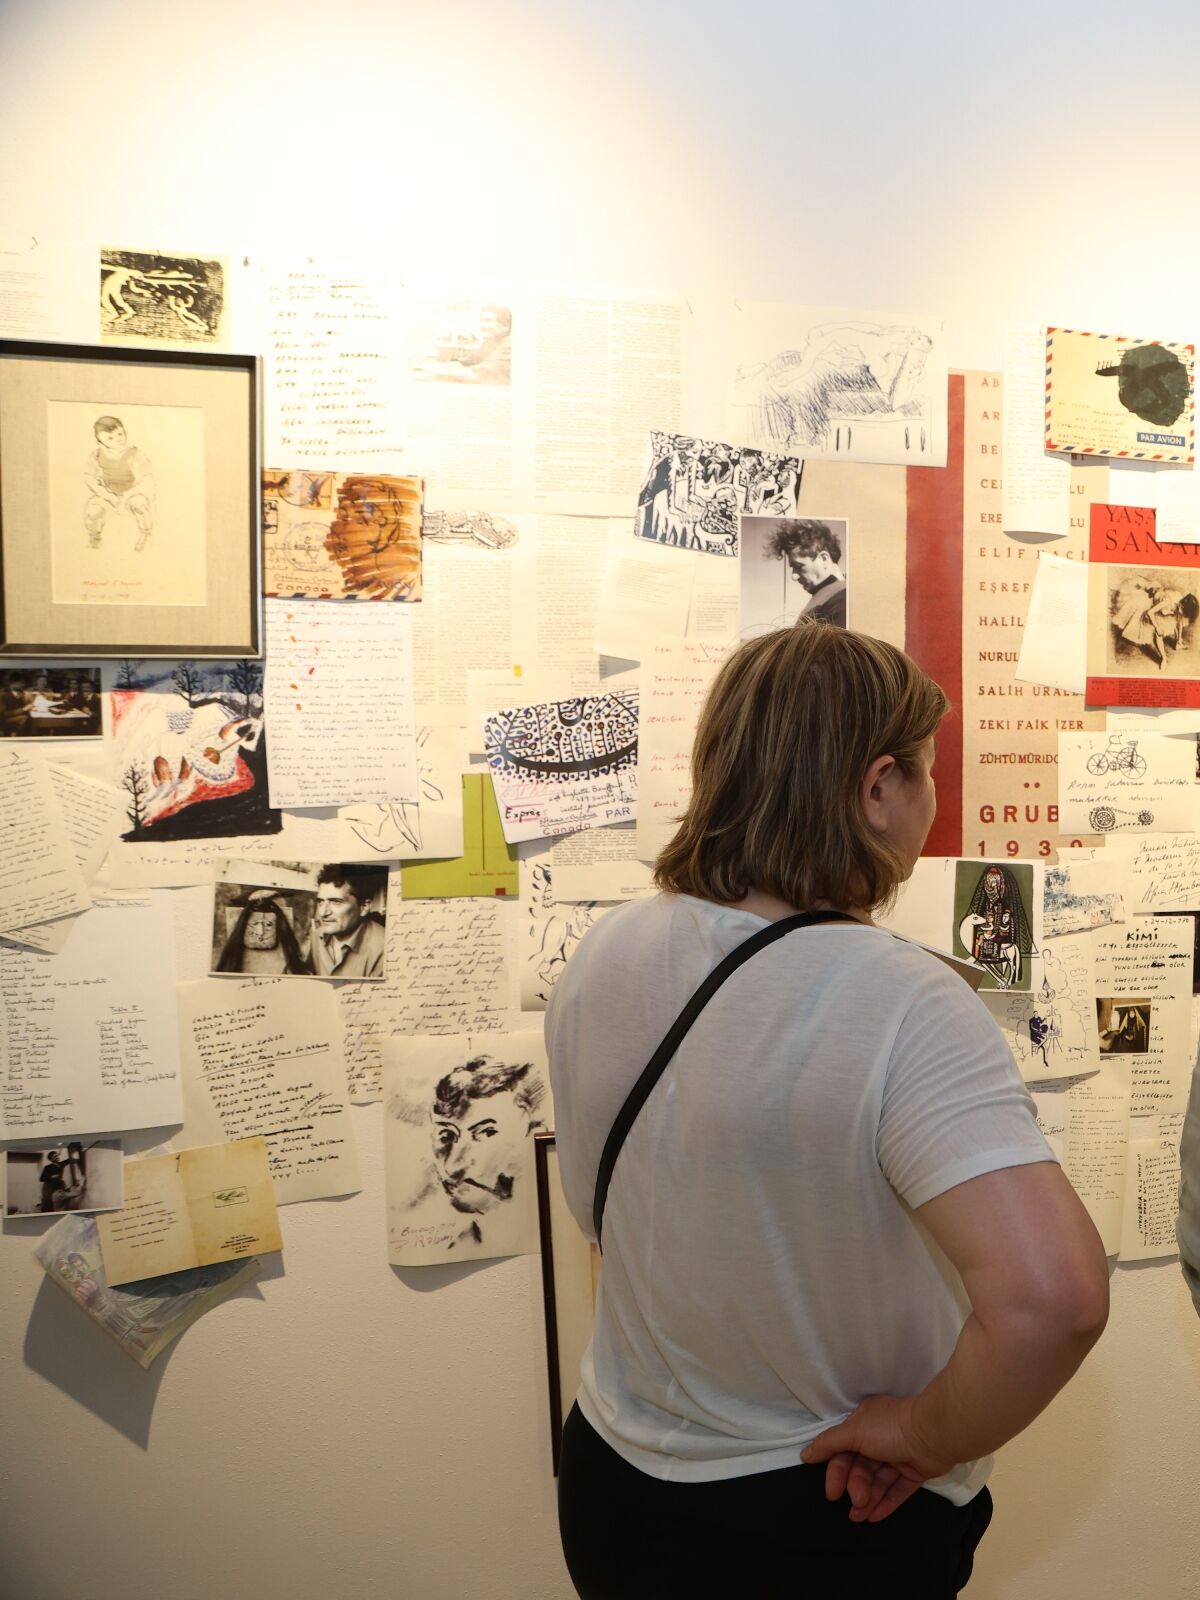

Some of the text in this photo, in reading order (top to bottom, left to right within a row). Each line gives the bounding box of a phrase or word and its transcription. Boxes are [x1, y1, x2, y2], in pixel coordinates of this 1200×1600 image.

[979, 546, 1025, 560] ELİF
[979, 583, 1031, 595] EŞREF
[978, 684, 1024, 697] SALİH
[1016, 717, 1049, 731] FAİK
[979, 751, 1017, 765] ZÜHTÜ
[605, 806, 631, 819] PAR
